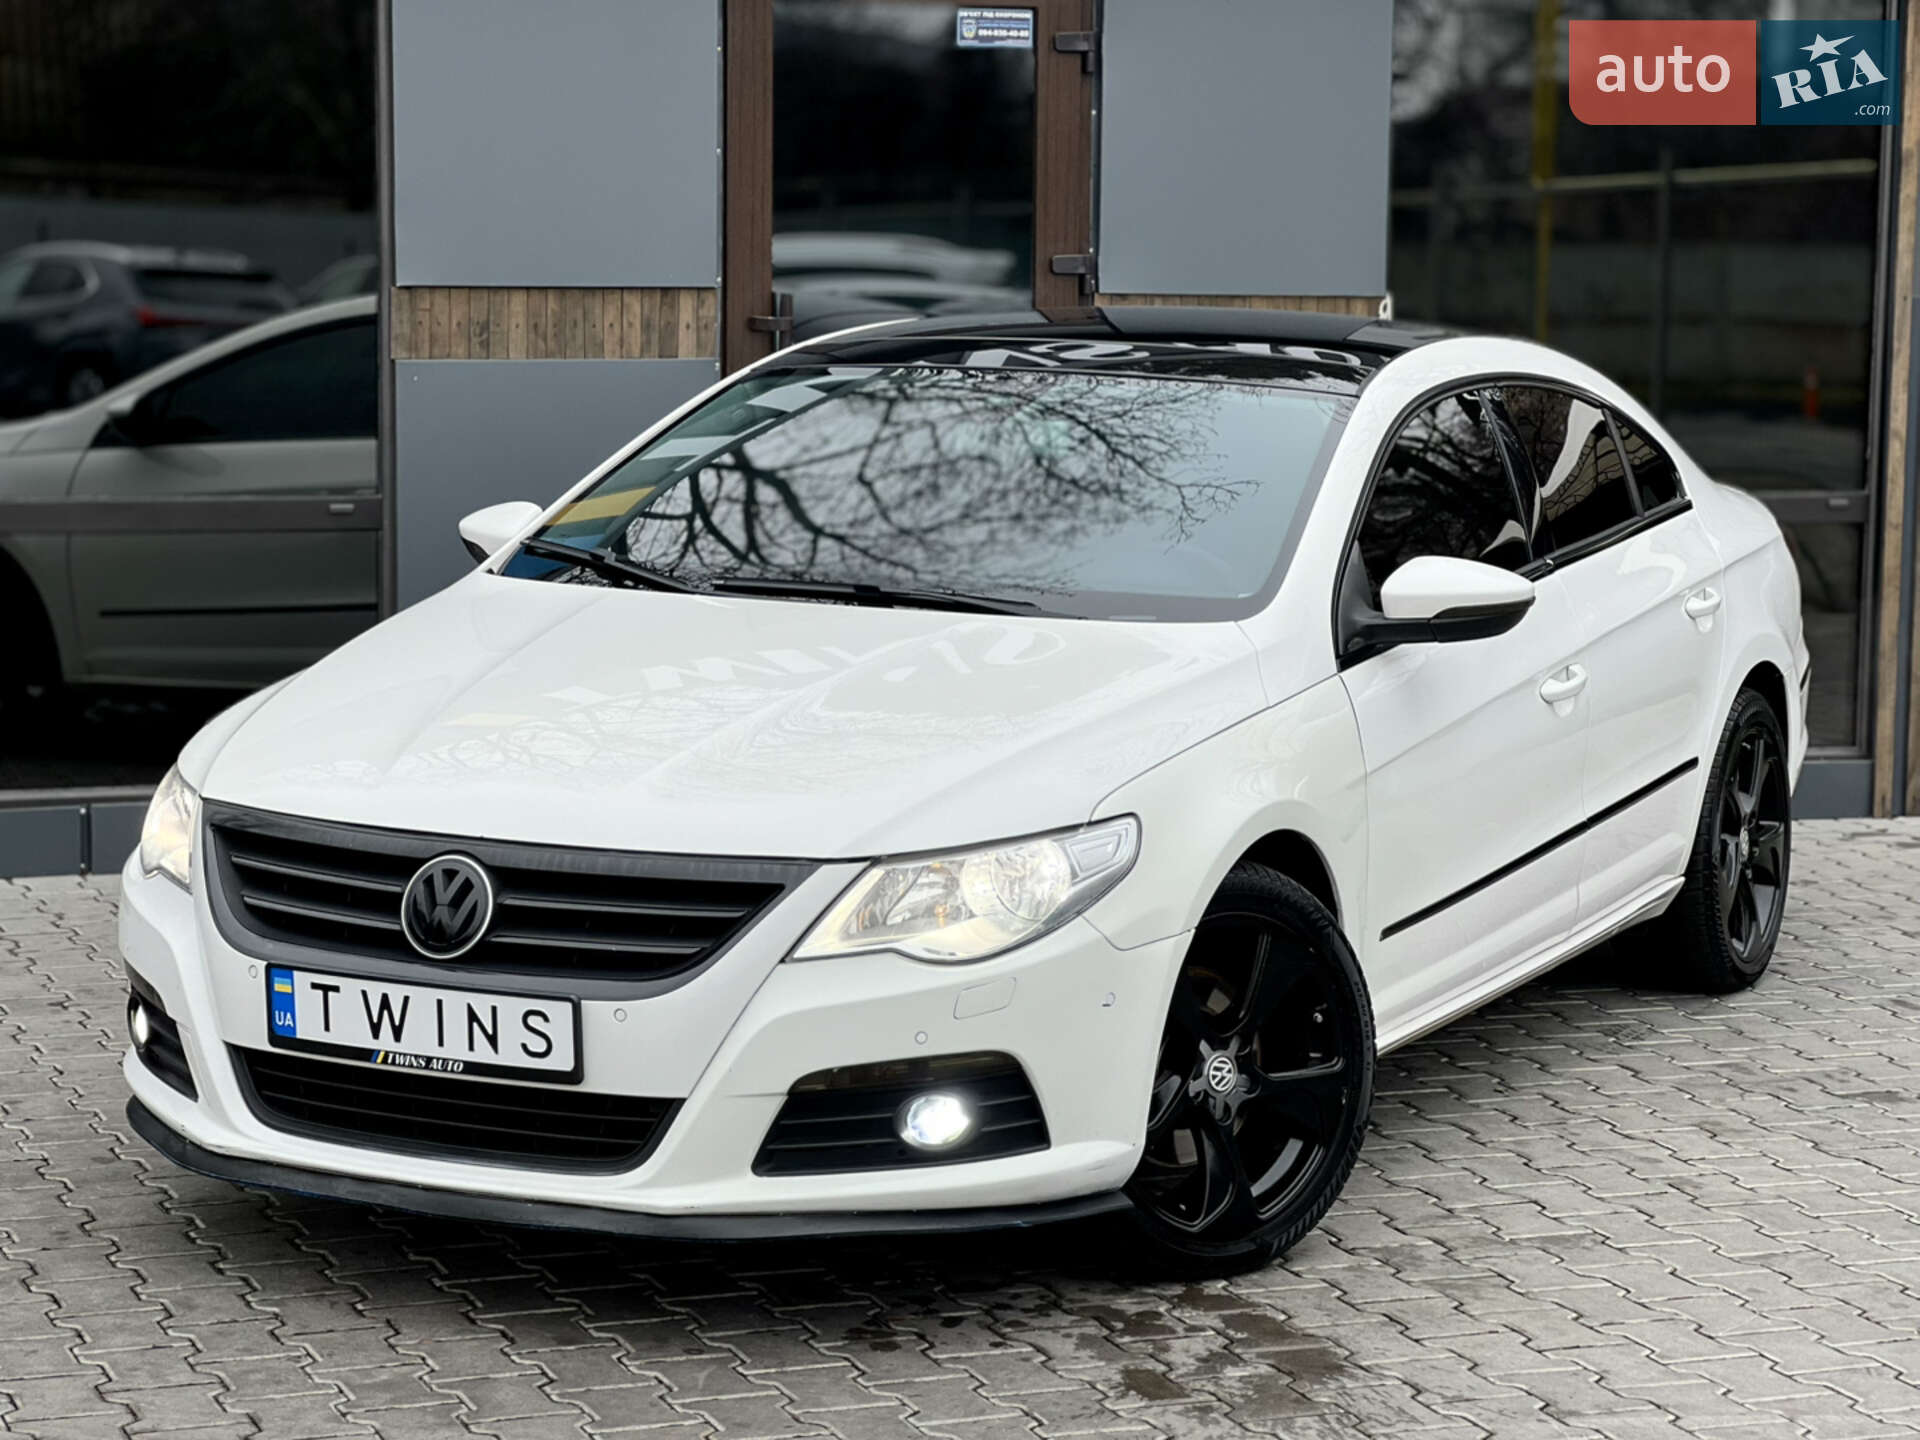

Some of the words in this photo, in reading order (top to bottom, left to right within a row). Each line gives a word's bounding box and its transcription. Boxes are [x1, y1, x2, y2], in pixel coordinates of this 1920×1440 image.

[275, 1010, 294, 1027] UA
[310, 982, 553, 1059] TWINS
[387, 1052, 427, 1068] TWINS
[429, 1058, 464, 1073] AUTO
